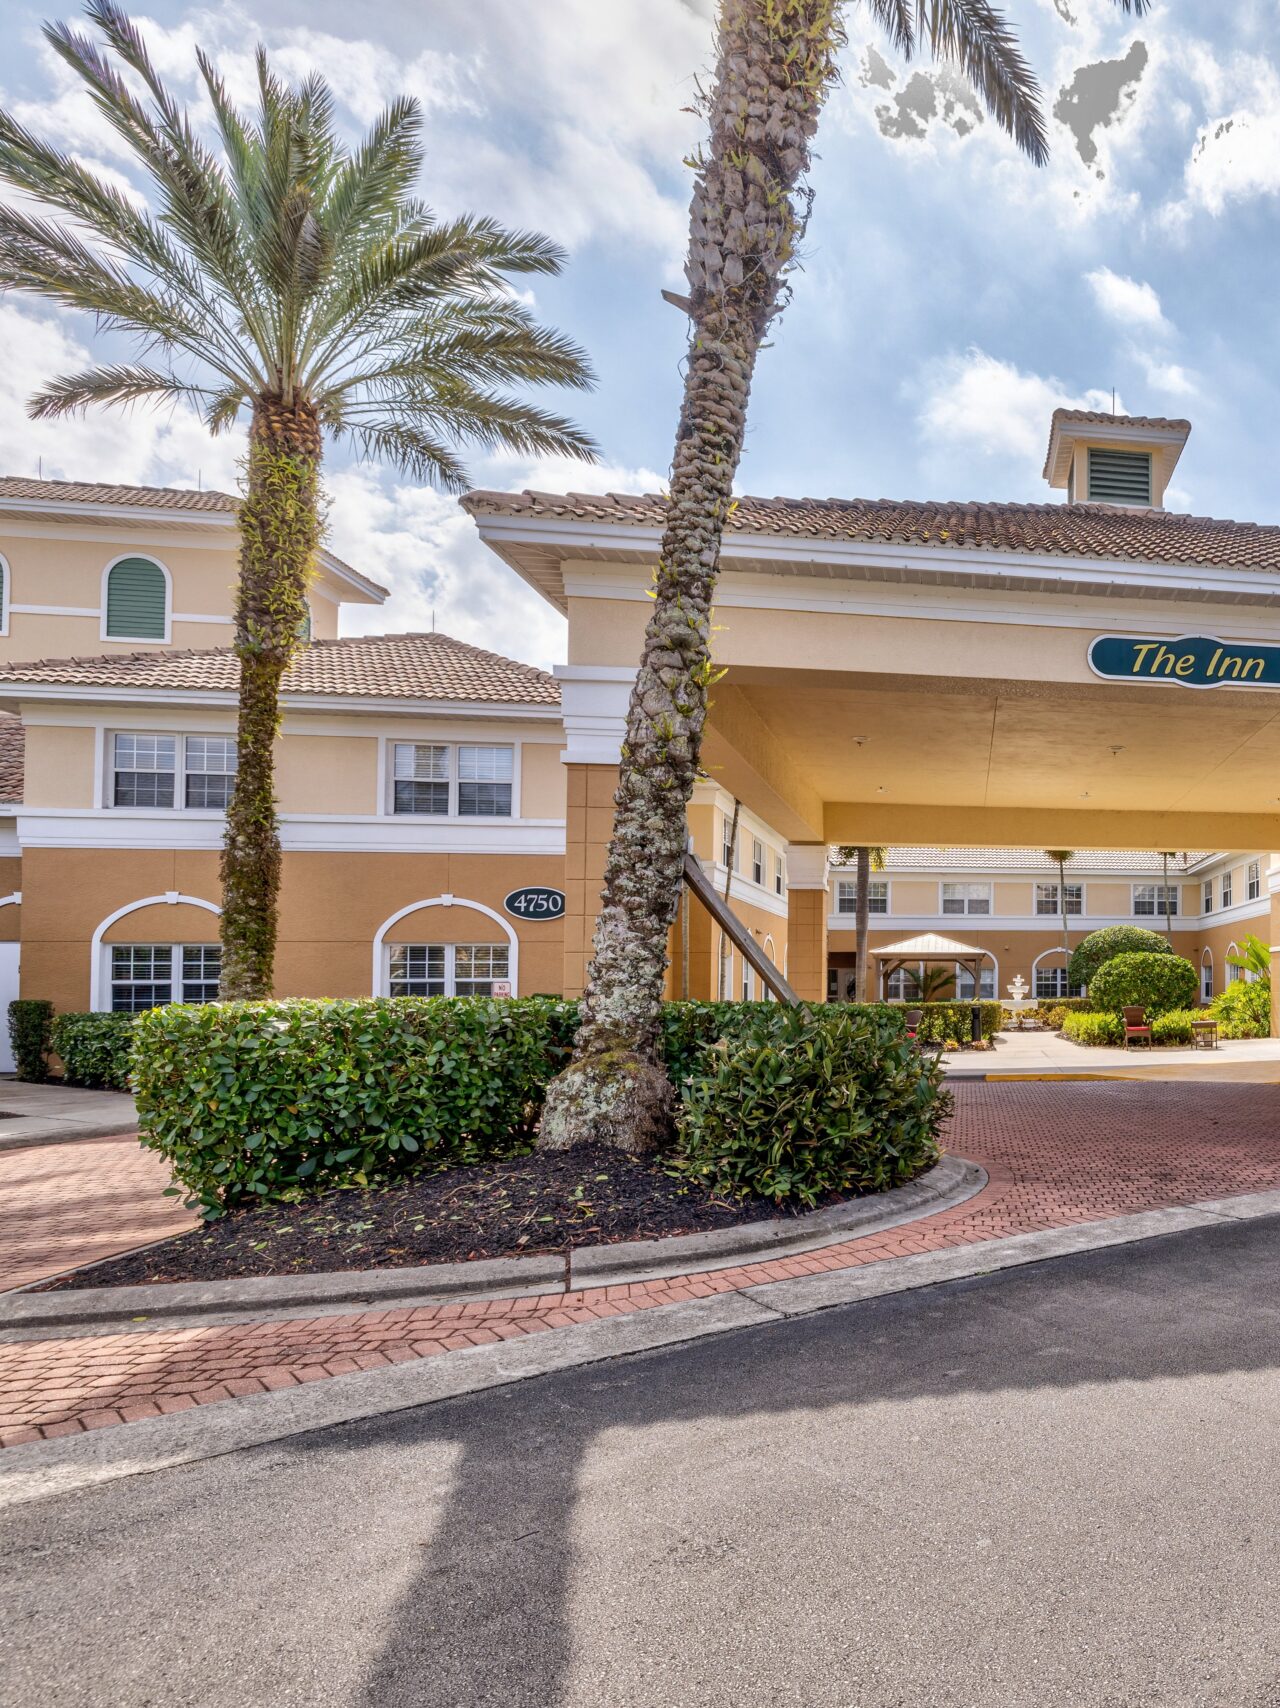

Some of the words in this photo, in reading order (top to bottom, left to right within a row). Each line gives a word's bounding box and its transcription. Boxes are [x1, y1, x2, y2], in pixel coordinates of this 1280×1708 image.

[1132, 643, 1195, 676] The
[1206, 648, 1265, 679] Inn
[513, 894, 562, 912] 4750
